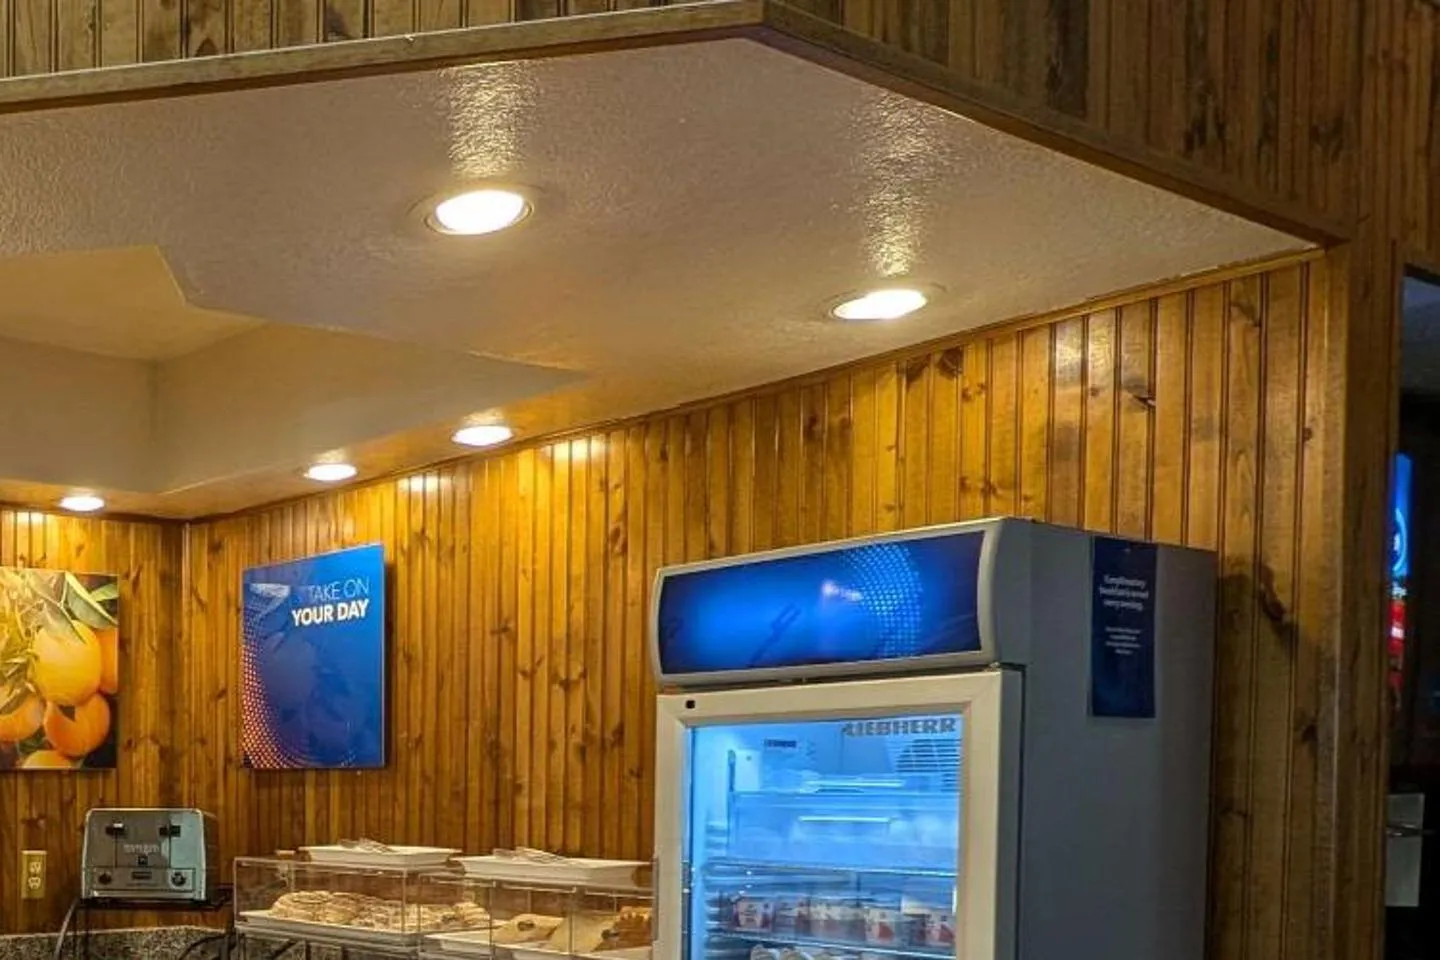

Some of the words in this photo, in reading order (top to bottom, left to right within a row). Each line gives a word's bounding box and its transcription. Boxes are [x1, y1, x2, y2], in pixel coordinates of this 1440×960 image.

[307, 581, 340, 602] TAKE
[343, 576, 370, 599] ON
[291, 603, 334, 627] YOUR
[337, 598, 370, 620] DAY
[842, 717, 957, 737] LIEBHERR
